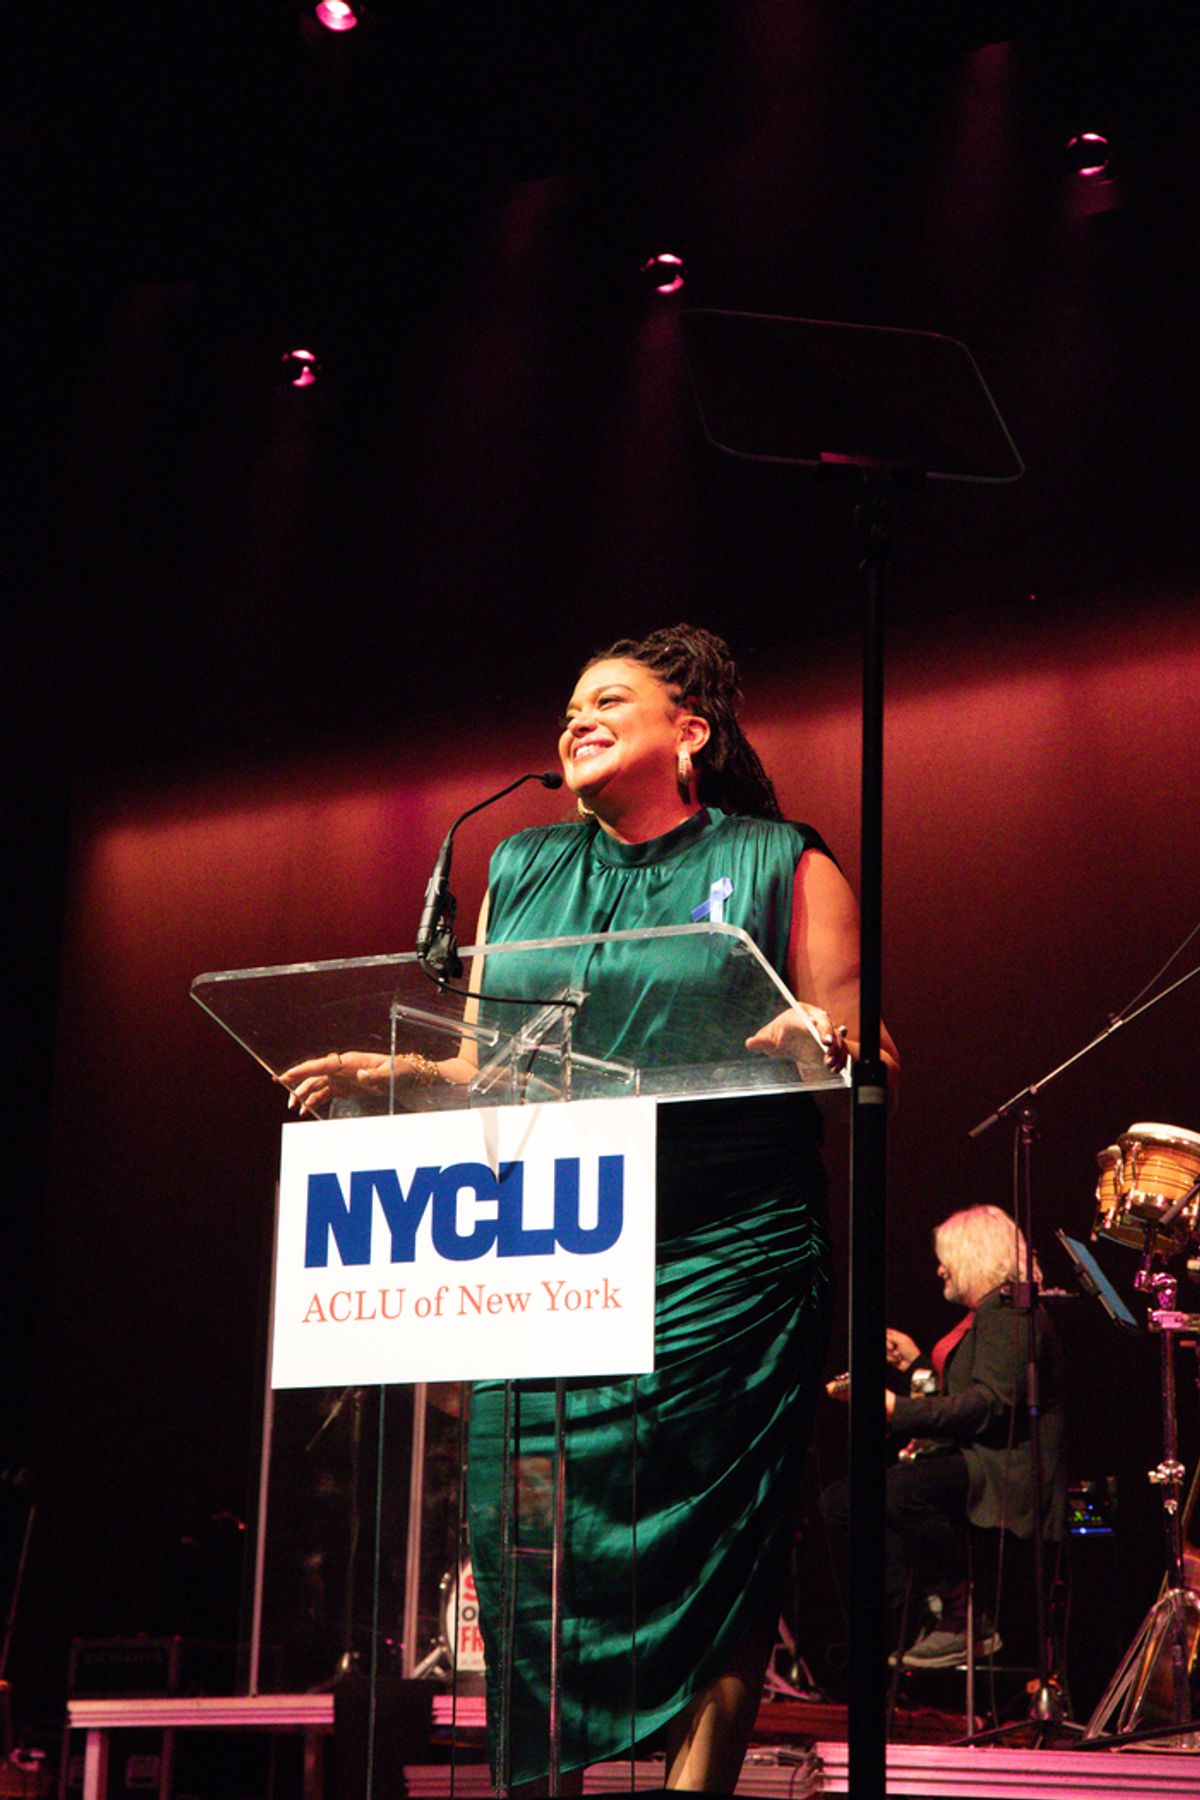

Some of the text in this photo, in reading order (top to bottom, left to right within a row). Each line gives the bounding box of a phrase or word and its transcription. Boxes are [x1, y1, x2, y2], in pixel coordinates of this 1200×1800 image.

[305, 1154, 625, 1268] NYCLU
[302, 1278, 622, 1323] ACLU of New York
